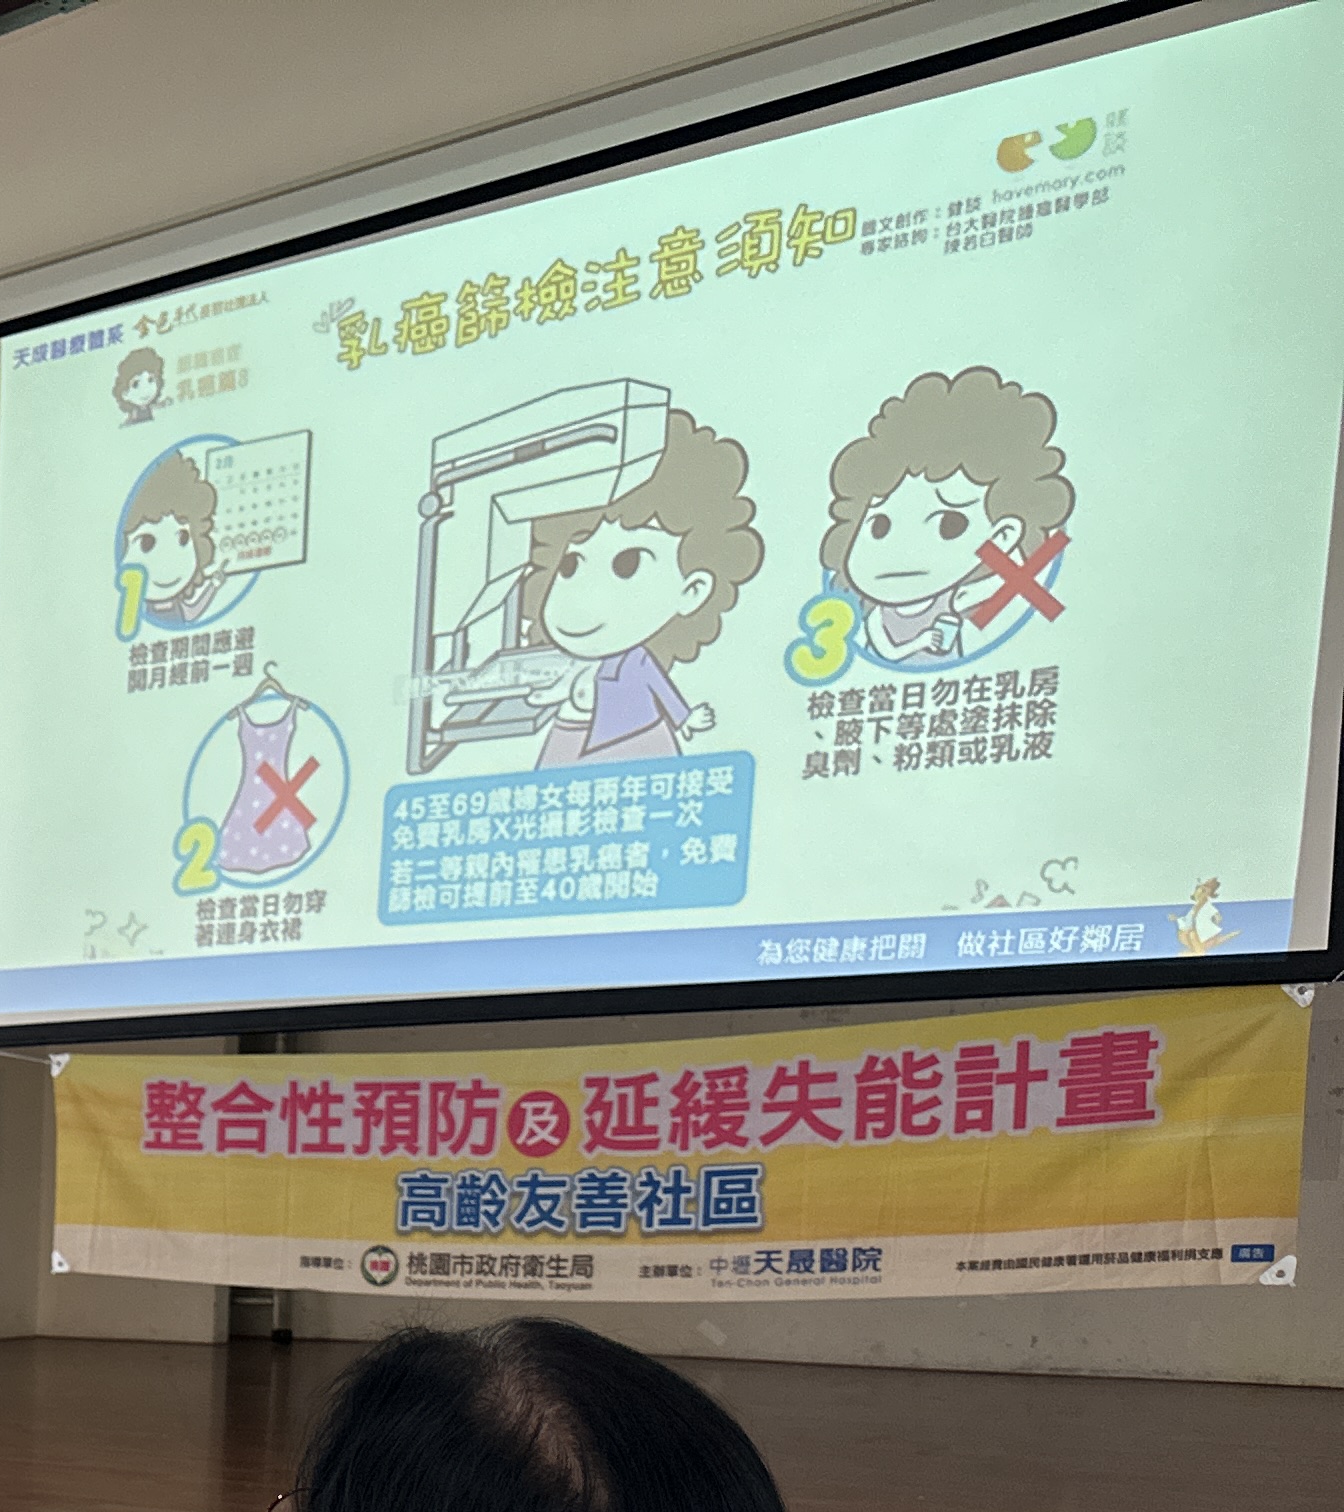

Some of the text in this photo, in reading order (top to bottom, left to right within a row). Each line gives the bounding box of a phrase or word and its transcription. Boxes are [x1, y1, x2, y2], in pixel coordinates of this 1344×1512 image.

[336, 203, 858, 371] 乳癌篩檢注意須知
[116, 563, 147, 642] 1
[129, 625, 255, 666] 檢查期間應避
[784, 592, 862, 687] 3
[127, 652, 253, 693] 開月經前一週
[807, 665, 1059, 720] 檢查當日勿在乳房
[814, 698, 1057, 746] 、腋下等處塗抹除
[802, 731, 1055, 780] 臭劑、粉類或乳液
[393, 766, 734, 821] 45至69歲婦女每兩年可接受
[392, 799, 703, 851] 免費乳房X光攝影檢查一次
[173, 816, 223, 897] 2
[197, 889, 327, 921] 檢查當日勿穿
[388, 870, 658, 914] 篩檢可提前至40歲開始
[757, 923, 1144, 966] 為您健康把關 做社區好鄰居
[143, 1031, 1159, 1157] 整合性預防及延緩失能計畫
[398, 1168, 761, 1232] 高齡友善社區
[406, 1252, 594, 1278] 桃園市政府衛生局
[775, 1276, 825, 1287] General
[830, 1274, 882, 1285] Hospital
